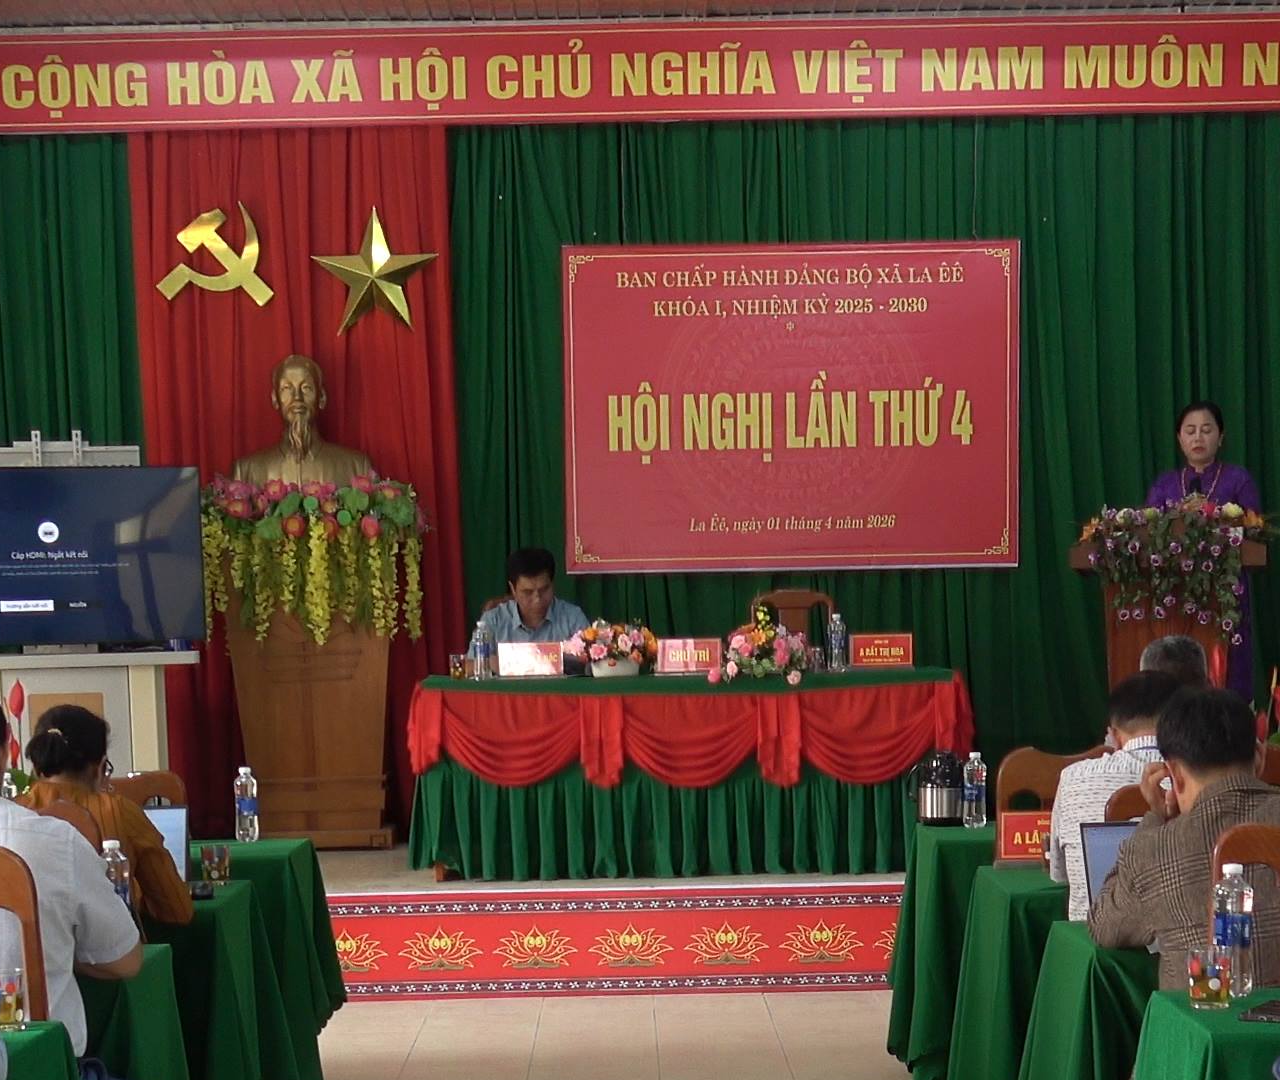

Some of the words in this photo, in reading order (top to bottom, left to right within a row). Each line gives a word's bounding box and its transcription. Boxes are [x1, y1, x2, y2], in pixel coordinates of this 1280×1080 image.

[1, 54, 149, 118] CỘNG
[166, 49, 275, 106] HÒA
[290, 49, 363, 103] XÃ
[379, 47, 467, 111] HỘI
[486, 38, 592, 100] CHỦ
[610, 41, 777, 97] NGHĨA
[792, 39, 904, 103] VIỆT
[921, 46, 1044, 92] NAM
[1063, 34, 1224, 89] MUÔN
[616, 270, 657, 289] BAN
[662, 263, 717, 288] CHẤP
[722, 264, 779, 287] HÀNH
[784, 262, 840, 286] ĐẢNG
[846, 263, 873, 289] BỘ
[876, 263, 903, 284] XÃ
[907, 267, 933, 284] LA
[938, 261, 964, 283] ÊÊ
[653, 295, 710, 318] KHÓA
[714, 299, 727, 319] I,
[732, 294, 798, 320] NHIỆM
[804, 292, 831, 315] KỲ
[834, 298, 874, 314] 2025
[888, 297, 928, 313] 2030
[607, 381, 671, 465] HỘI
[683, 391, 773, 463] NGHỊ
[784, 370, 857, 449] LẦN
[868, 376, 944, 448] THỨ
[951, 389, 974, 446] 4
[689, 517, 706, 532] La
[732, 517, 765, 534] ngày
[766, 516, 781, 531] 01
[785, 515, 822, 533] tháng
[824, 515, 833, 530] 4
[835, 514, 864, 530] năm
[866, 513, 896, 529] 2026
[1013, 831, 1023, 845] A
